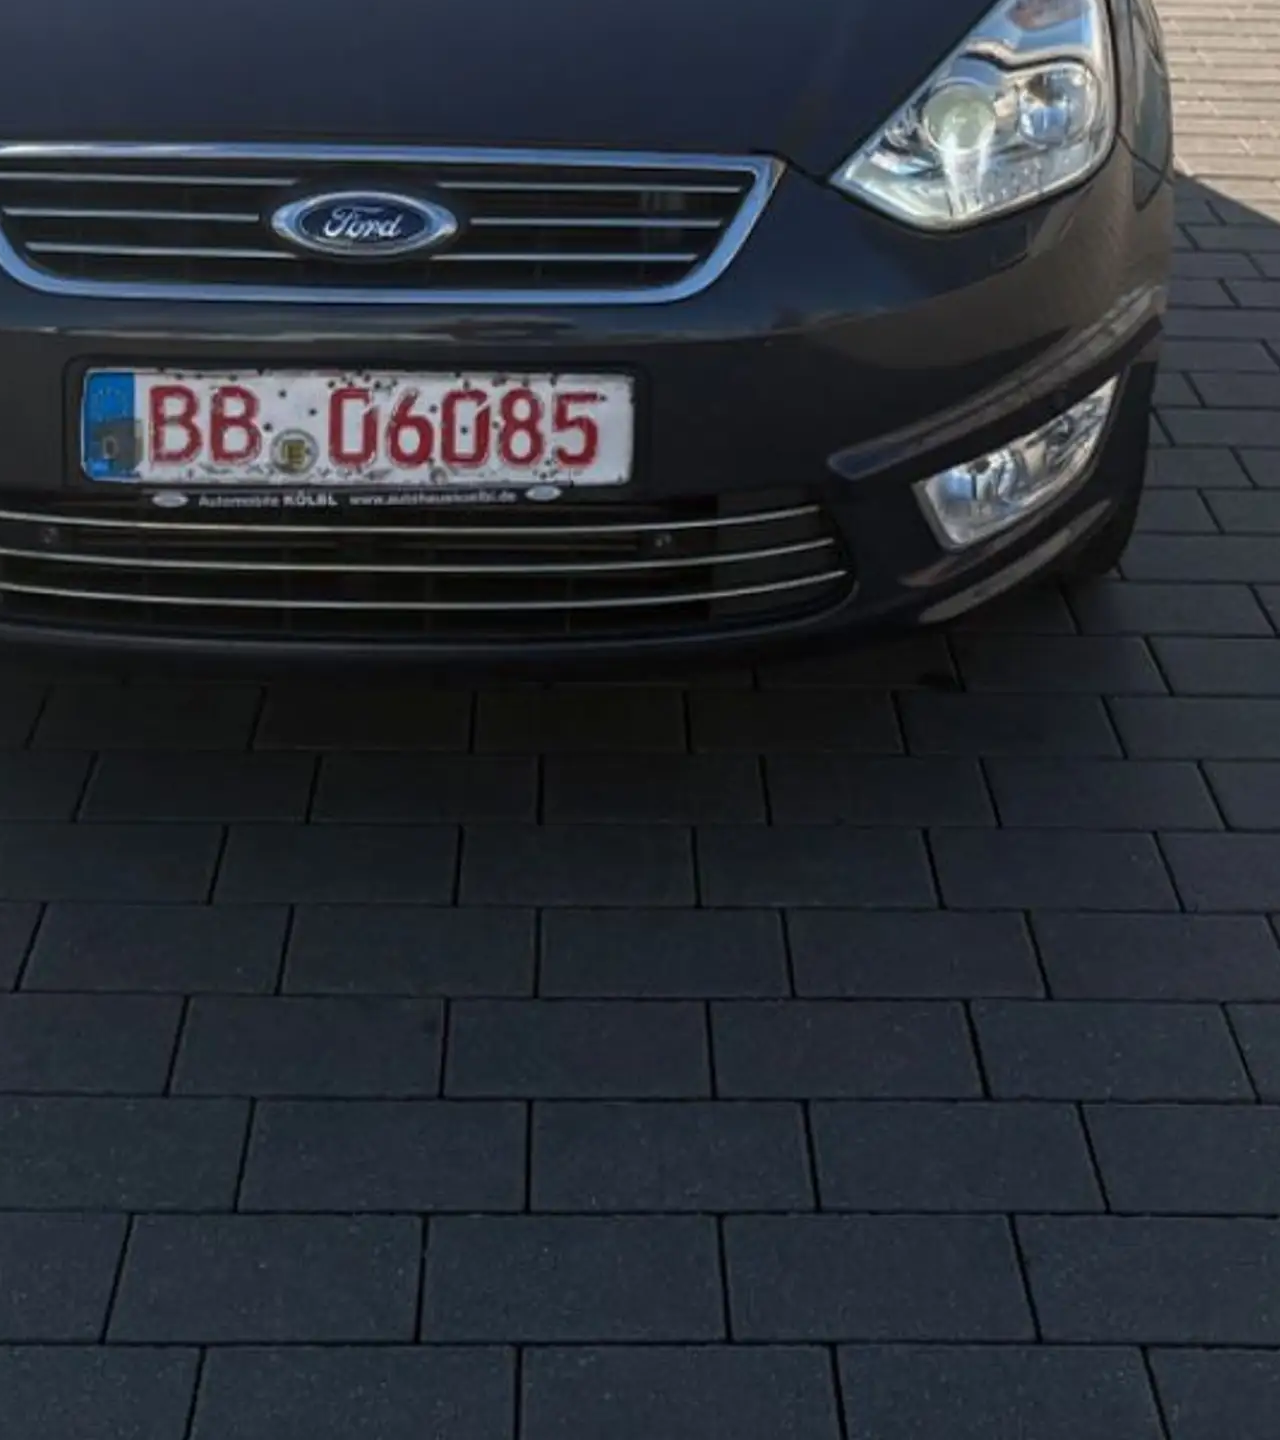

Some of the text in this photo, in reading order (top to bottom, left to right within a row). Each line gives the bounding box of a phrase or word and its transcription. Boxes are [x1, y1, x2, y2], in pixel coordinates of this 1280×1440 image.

[323, 206, 403, 238] Ford
[148, 384, 263, 467] BB
[327, 386, 602, 469] 06085
